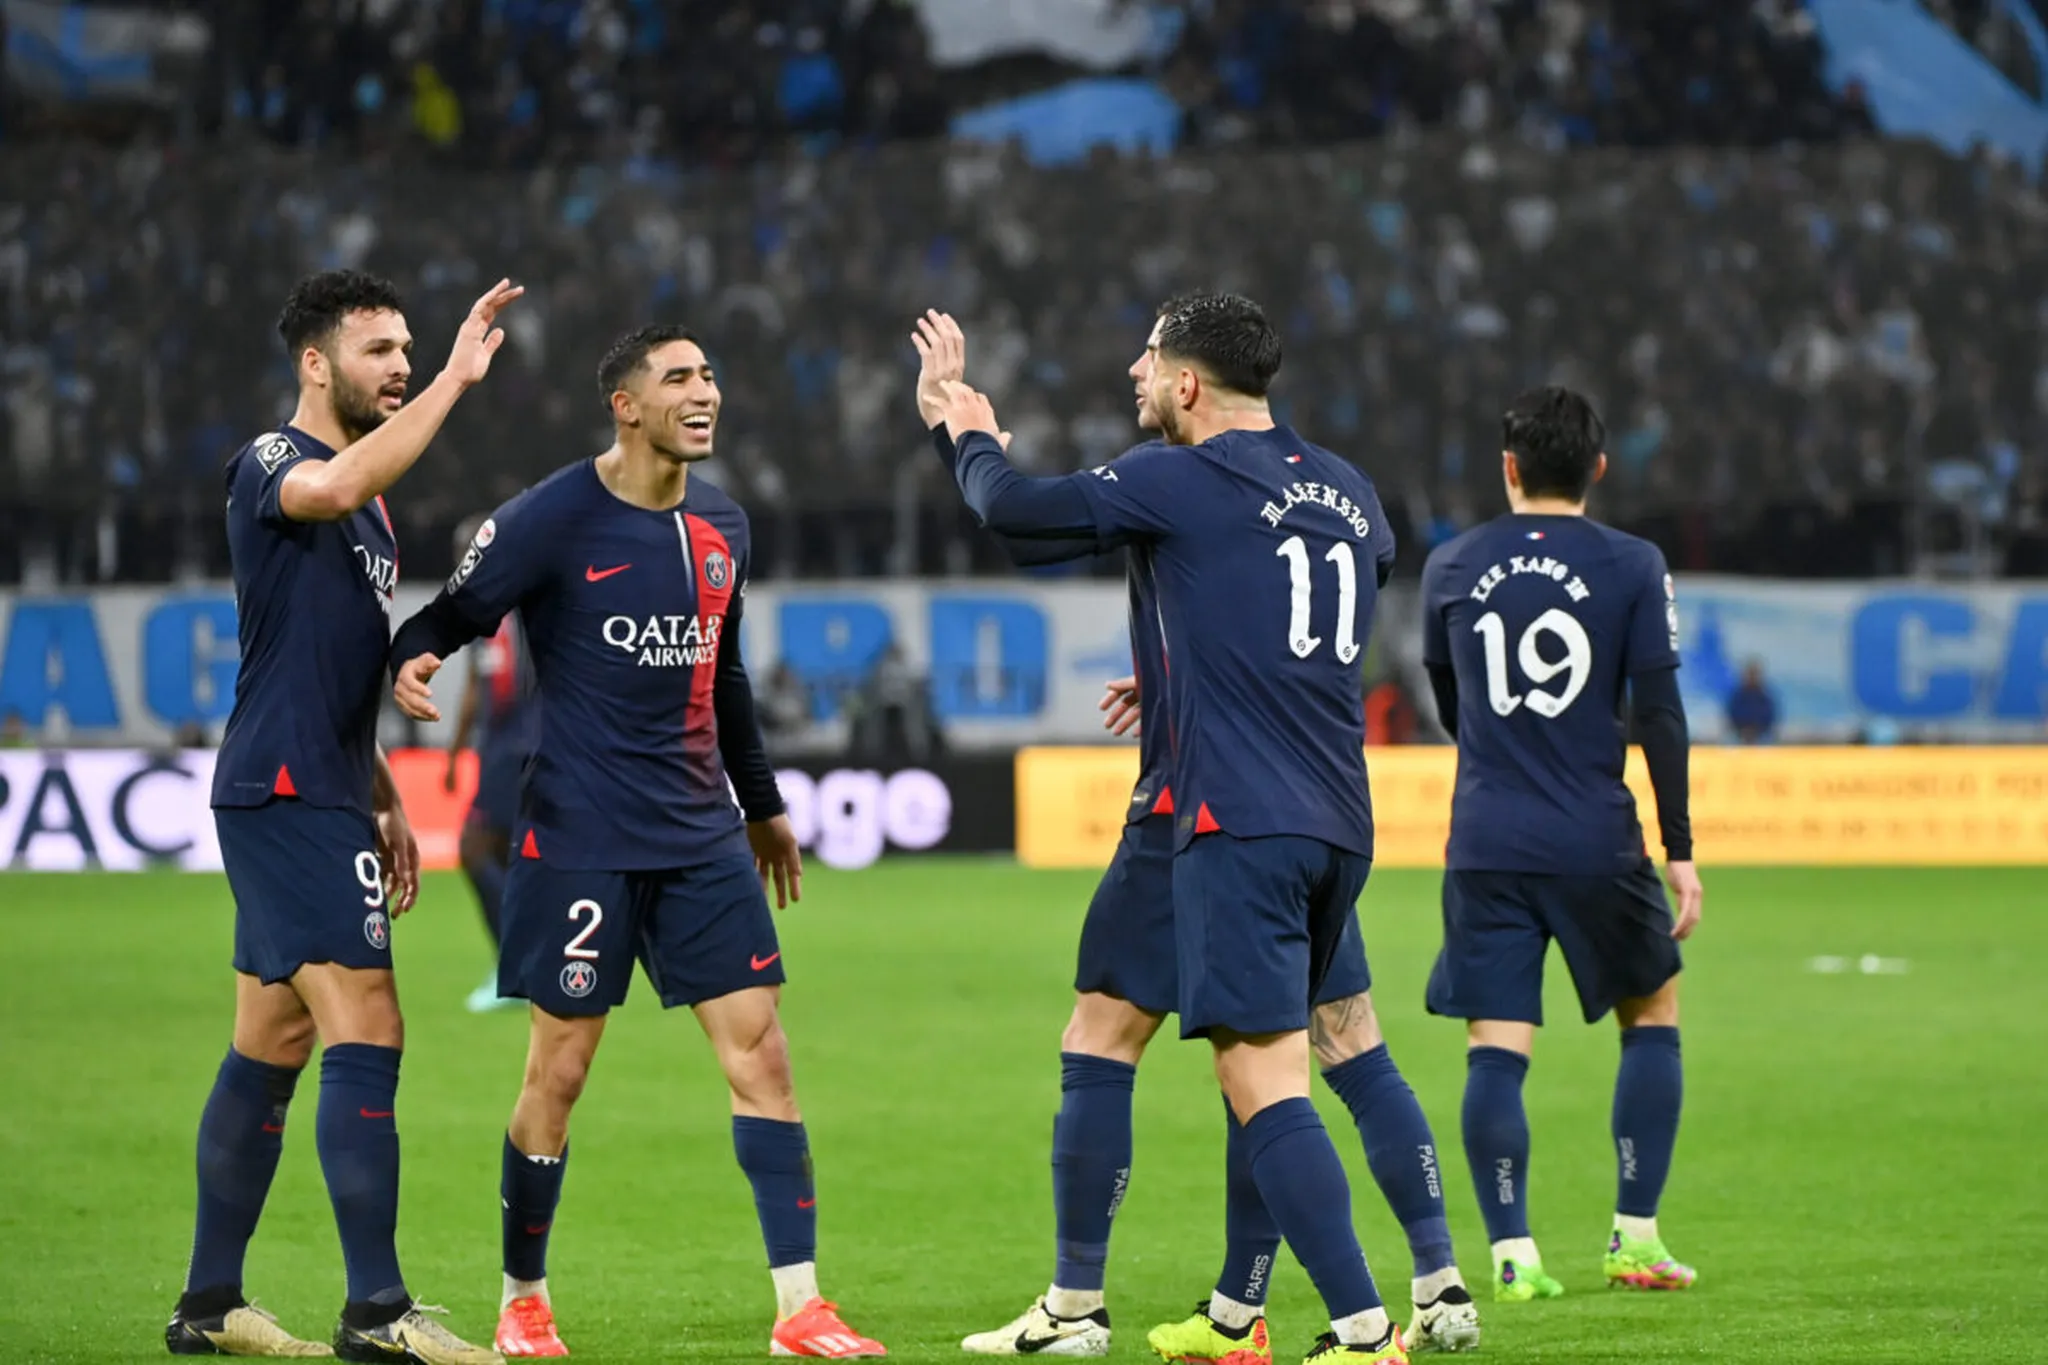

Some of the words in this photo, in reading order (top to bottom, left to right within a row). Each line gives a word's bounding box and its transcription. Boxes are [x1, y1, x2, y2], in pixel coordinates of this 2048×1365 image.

[1276, 535, 1360, 665] 11
[1470, 563, 1507, 604] LEE
[602, 614, 722, 653] QATAR
[637, 644, 717, 667] AIRWAYS
[1473, 607, 1592, 719] 19
[0, 754, 196, 861] AC
[354, 850, 384, 908] 9
[564, 898, 603, 959] 2
[1417, 1144, 1441, 1199] PARIS
[1496, 1157, 1515, 1205] PARIS
[1244, 1254, 1270, 1300] PARIS
